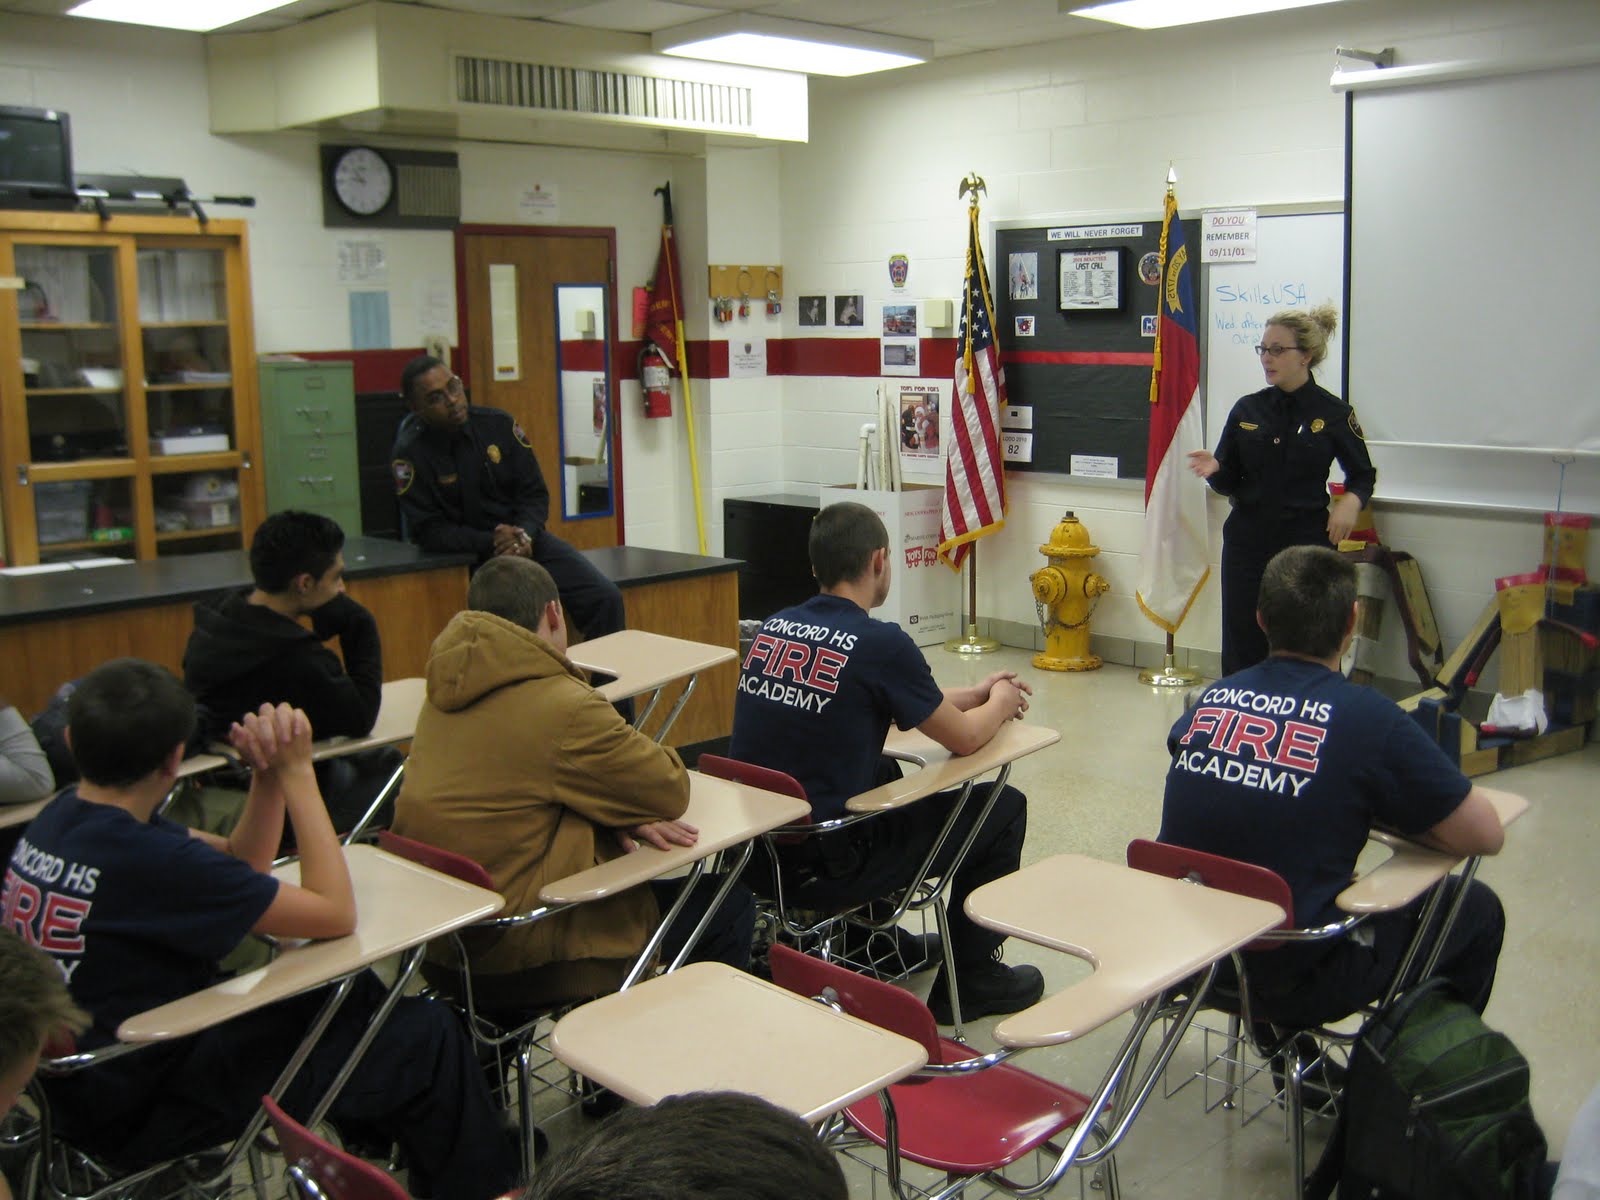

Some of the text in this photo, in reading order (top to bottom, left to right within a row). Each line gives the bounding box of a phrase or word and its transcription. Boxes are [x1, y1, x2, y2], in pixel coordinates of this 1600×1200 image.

[1212, 216, 1245, 225] DO YOU
[1051, 231, 1061, 239] WE
[1084, 229, 1108, 237] NEVER
[1111, 227, 1140, 235] FORGET
[1206, 232, 1250, 241] REMEMBER
[1209, 248, 1246, 257] 09/11/01
[1075, 262, 1104, 270] LAST CALL
[1007, 444, 1019, 455] 82
[906, 550, 937, 561] TOYS FOR
[763, 618, 858, 651] CONCORD HS
[743, 633, 849, 694] FIRE
[738, 674, 831, 713] ACADEMY
[1203, 688, 1332, 723] CONCORD HS
[1180, 707, 1327, 773] FIRE
[1175, 750, 1311, 797] ACADEMY
[63, 862, 101, 894] HS
